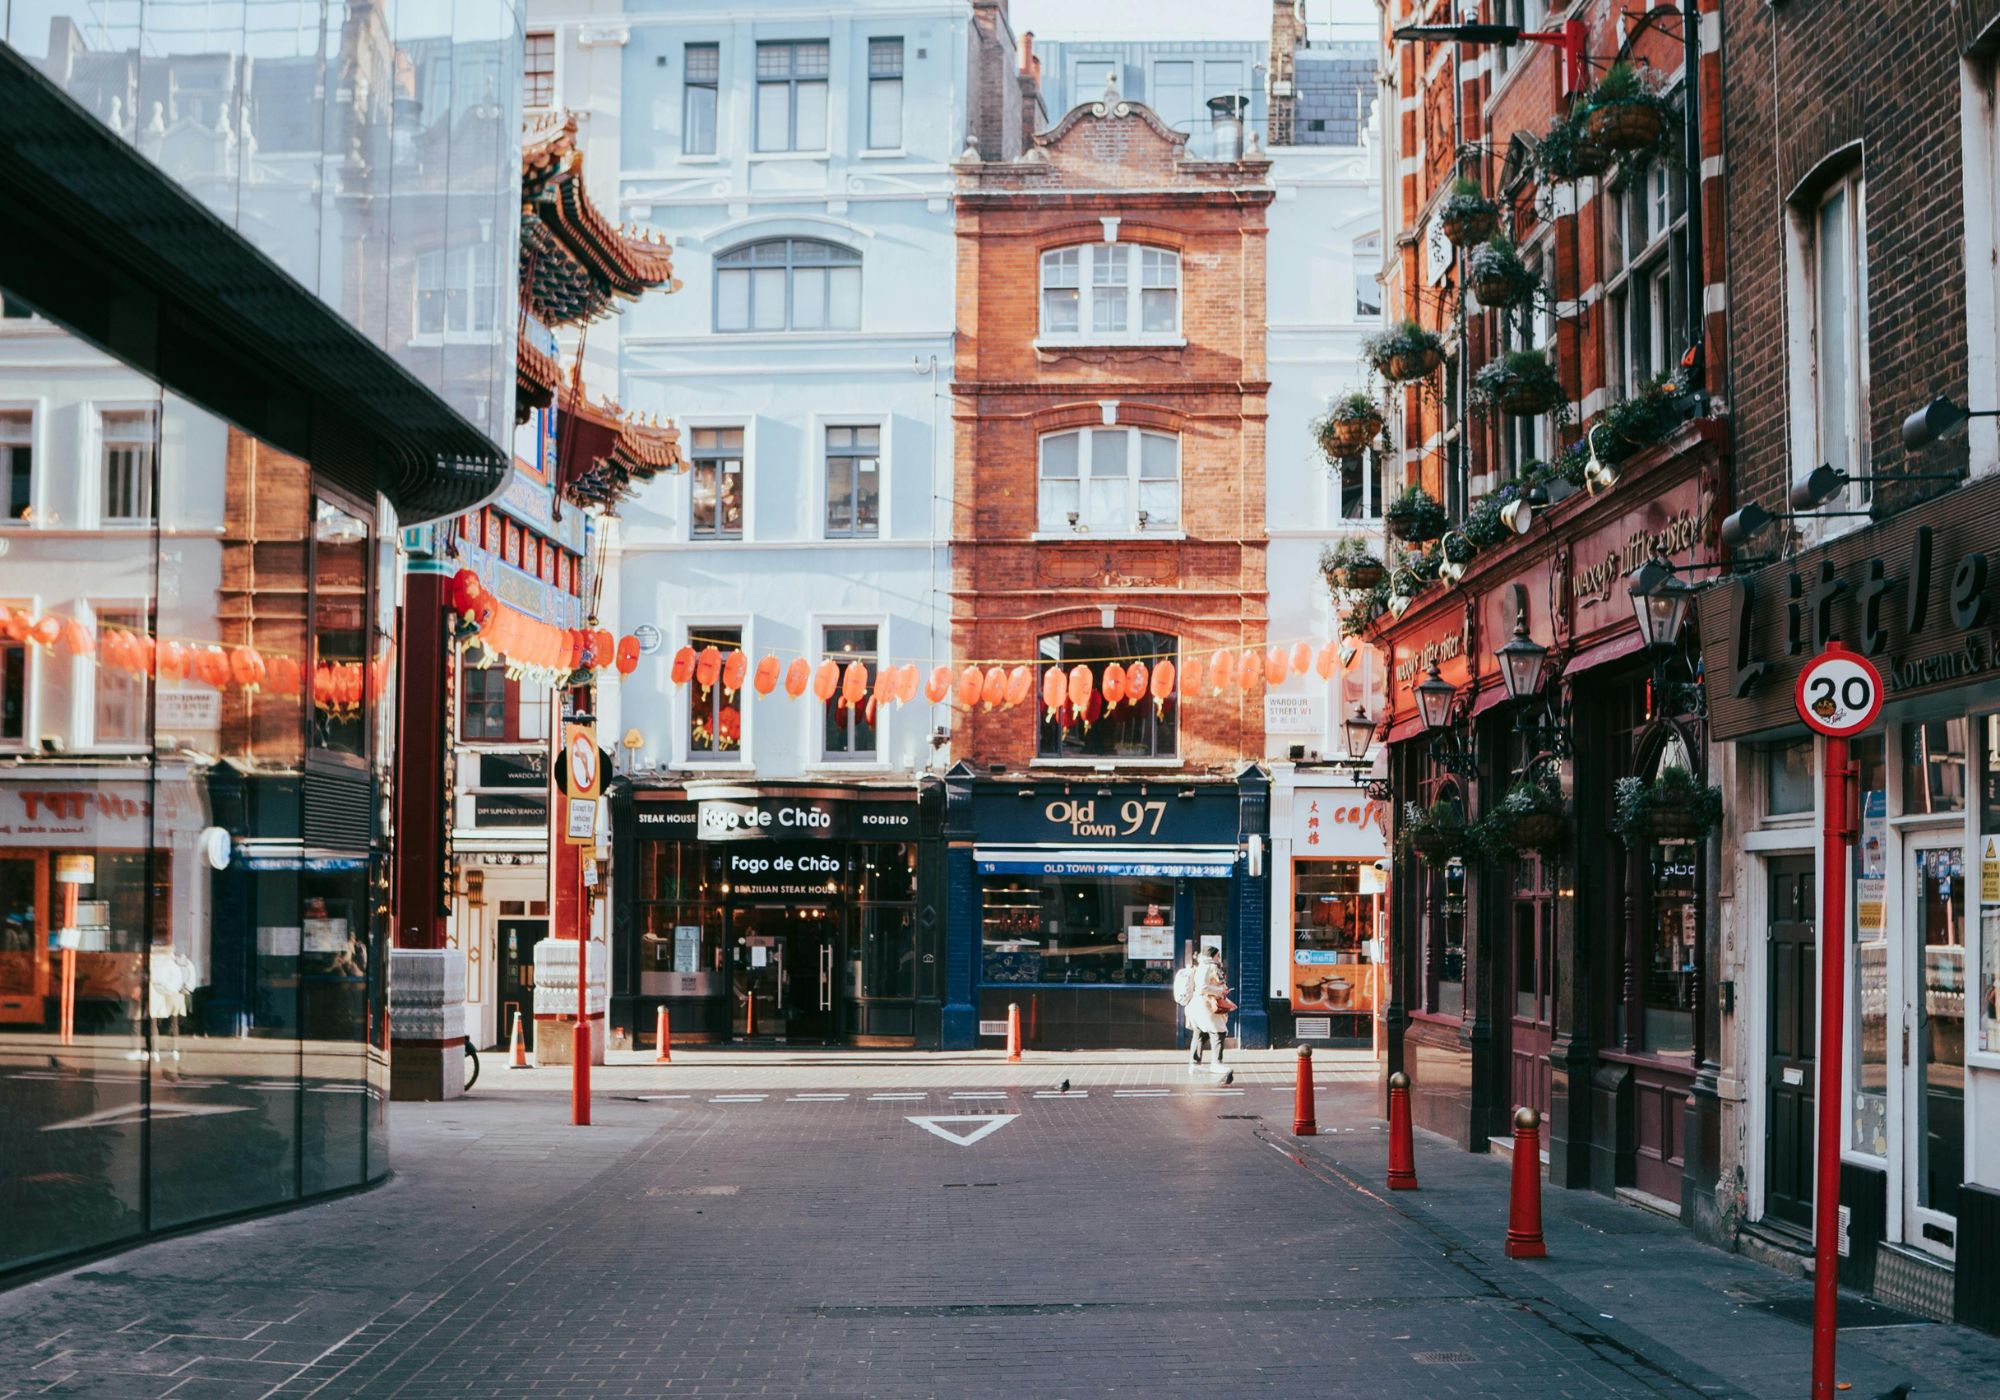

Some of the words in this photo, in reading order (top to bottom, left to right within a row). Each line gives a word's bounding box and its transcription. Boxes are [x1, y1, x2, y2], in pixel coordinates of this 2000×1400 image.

[1728, 526, 1988, 698] Little
[1889, 653, 1957, 691] Korean
[1961, 635, 1980, 675] &
[1270, 698, 1308, 706] WARDOUR
[1810, 677, 1870, 711] 20
[1270, 707, 1297, 716] STREET
[639, 814, 665, 823] STEAK
[667, 814, 697, 823] HOUSE
[702, 808, 740, 831] Fogo
[744, 807, 773, 827] de
[778, 807, 832, 828] Chão
[862, 815, 909, 825] RODIZIO
[1045, 800, 1095, 822] Old
[1121, 800, 1168, 836] 97
[1069, 820, 1117, 837] Town
[731, 855, 769, 873] Fogo
[774, 856, 794, 871] de
[798, 854, 840, 872] Chão
[1044, 864, 1064, 873] OLD
[1066, 864, 1095, 873] TOWN
[734, 885, 779, 894] BRAZILIAN
[780, 885, 807, 894] STEAK
[808, 886, 838, 894] HOUSE
